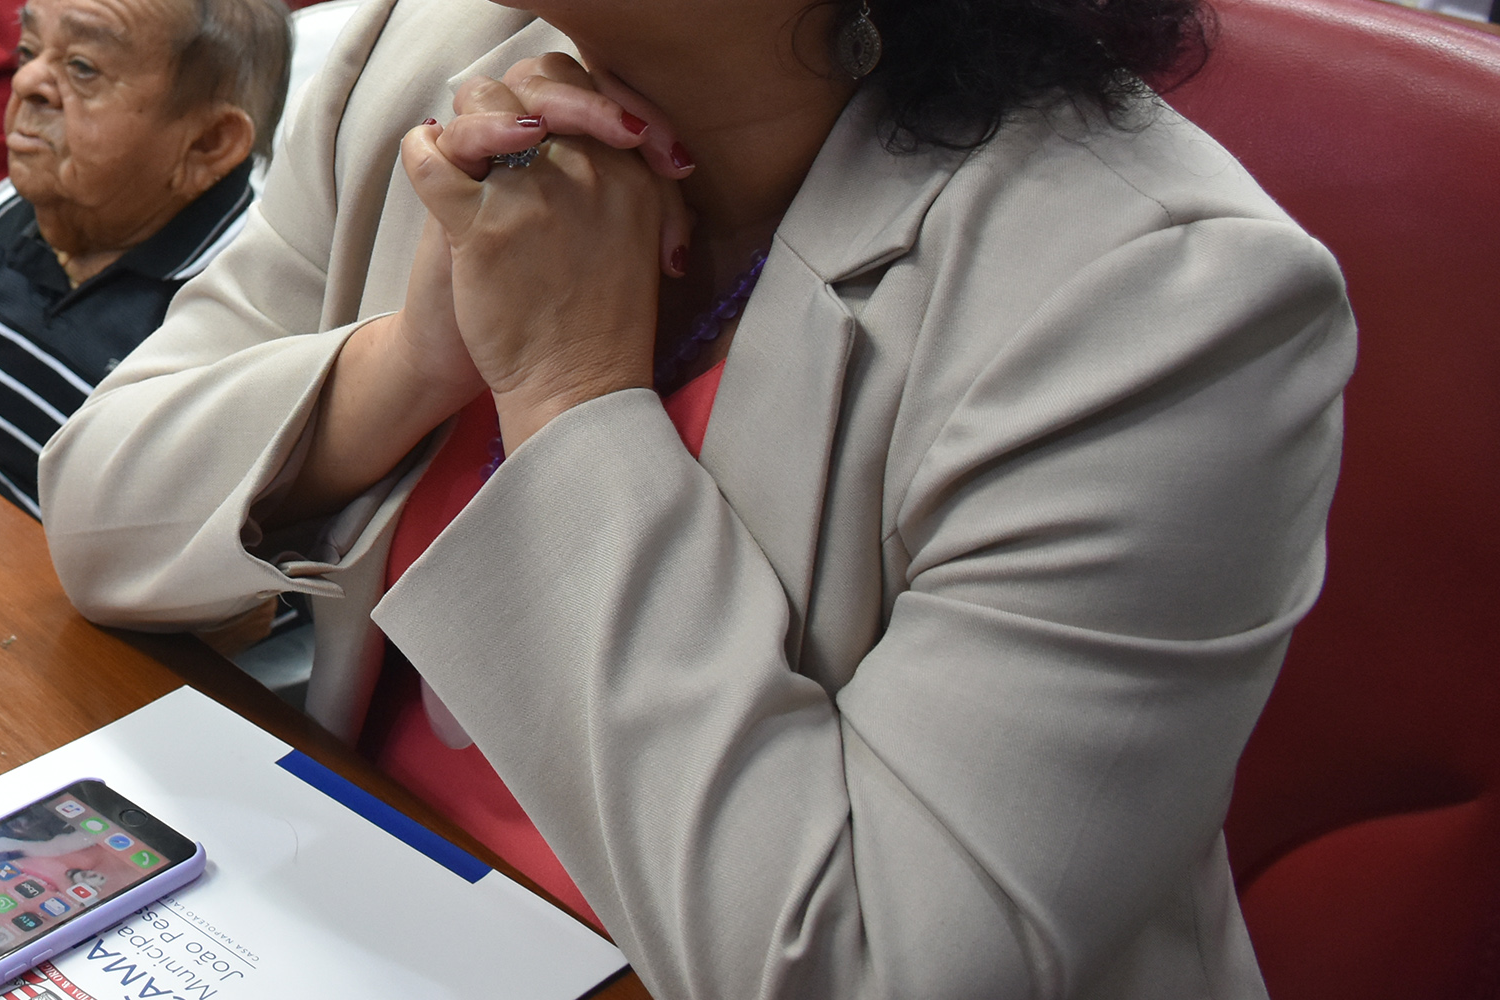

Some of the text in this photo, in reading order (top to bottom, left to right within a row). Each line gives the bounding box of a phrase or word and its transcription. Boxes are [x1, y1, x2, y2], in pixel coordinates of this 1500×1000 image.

[185, 911, 234, 945] NAPOLEÃO
[185, 941, 244, 981] João
[235, 943, 260, 963] CASA
